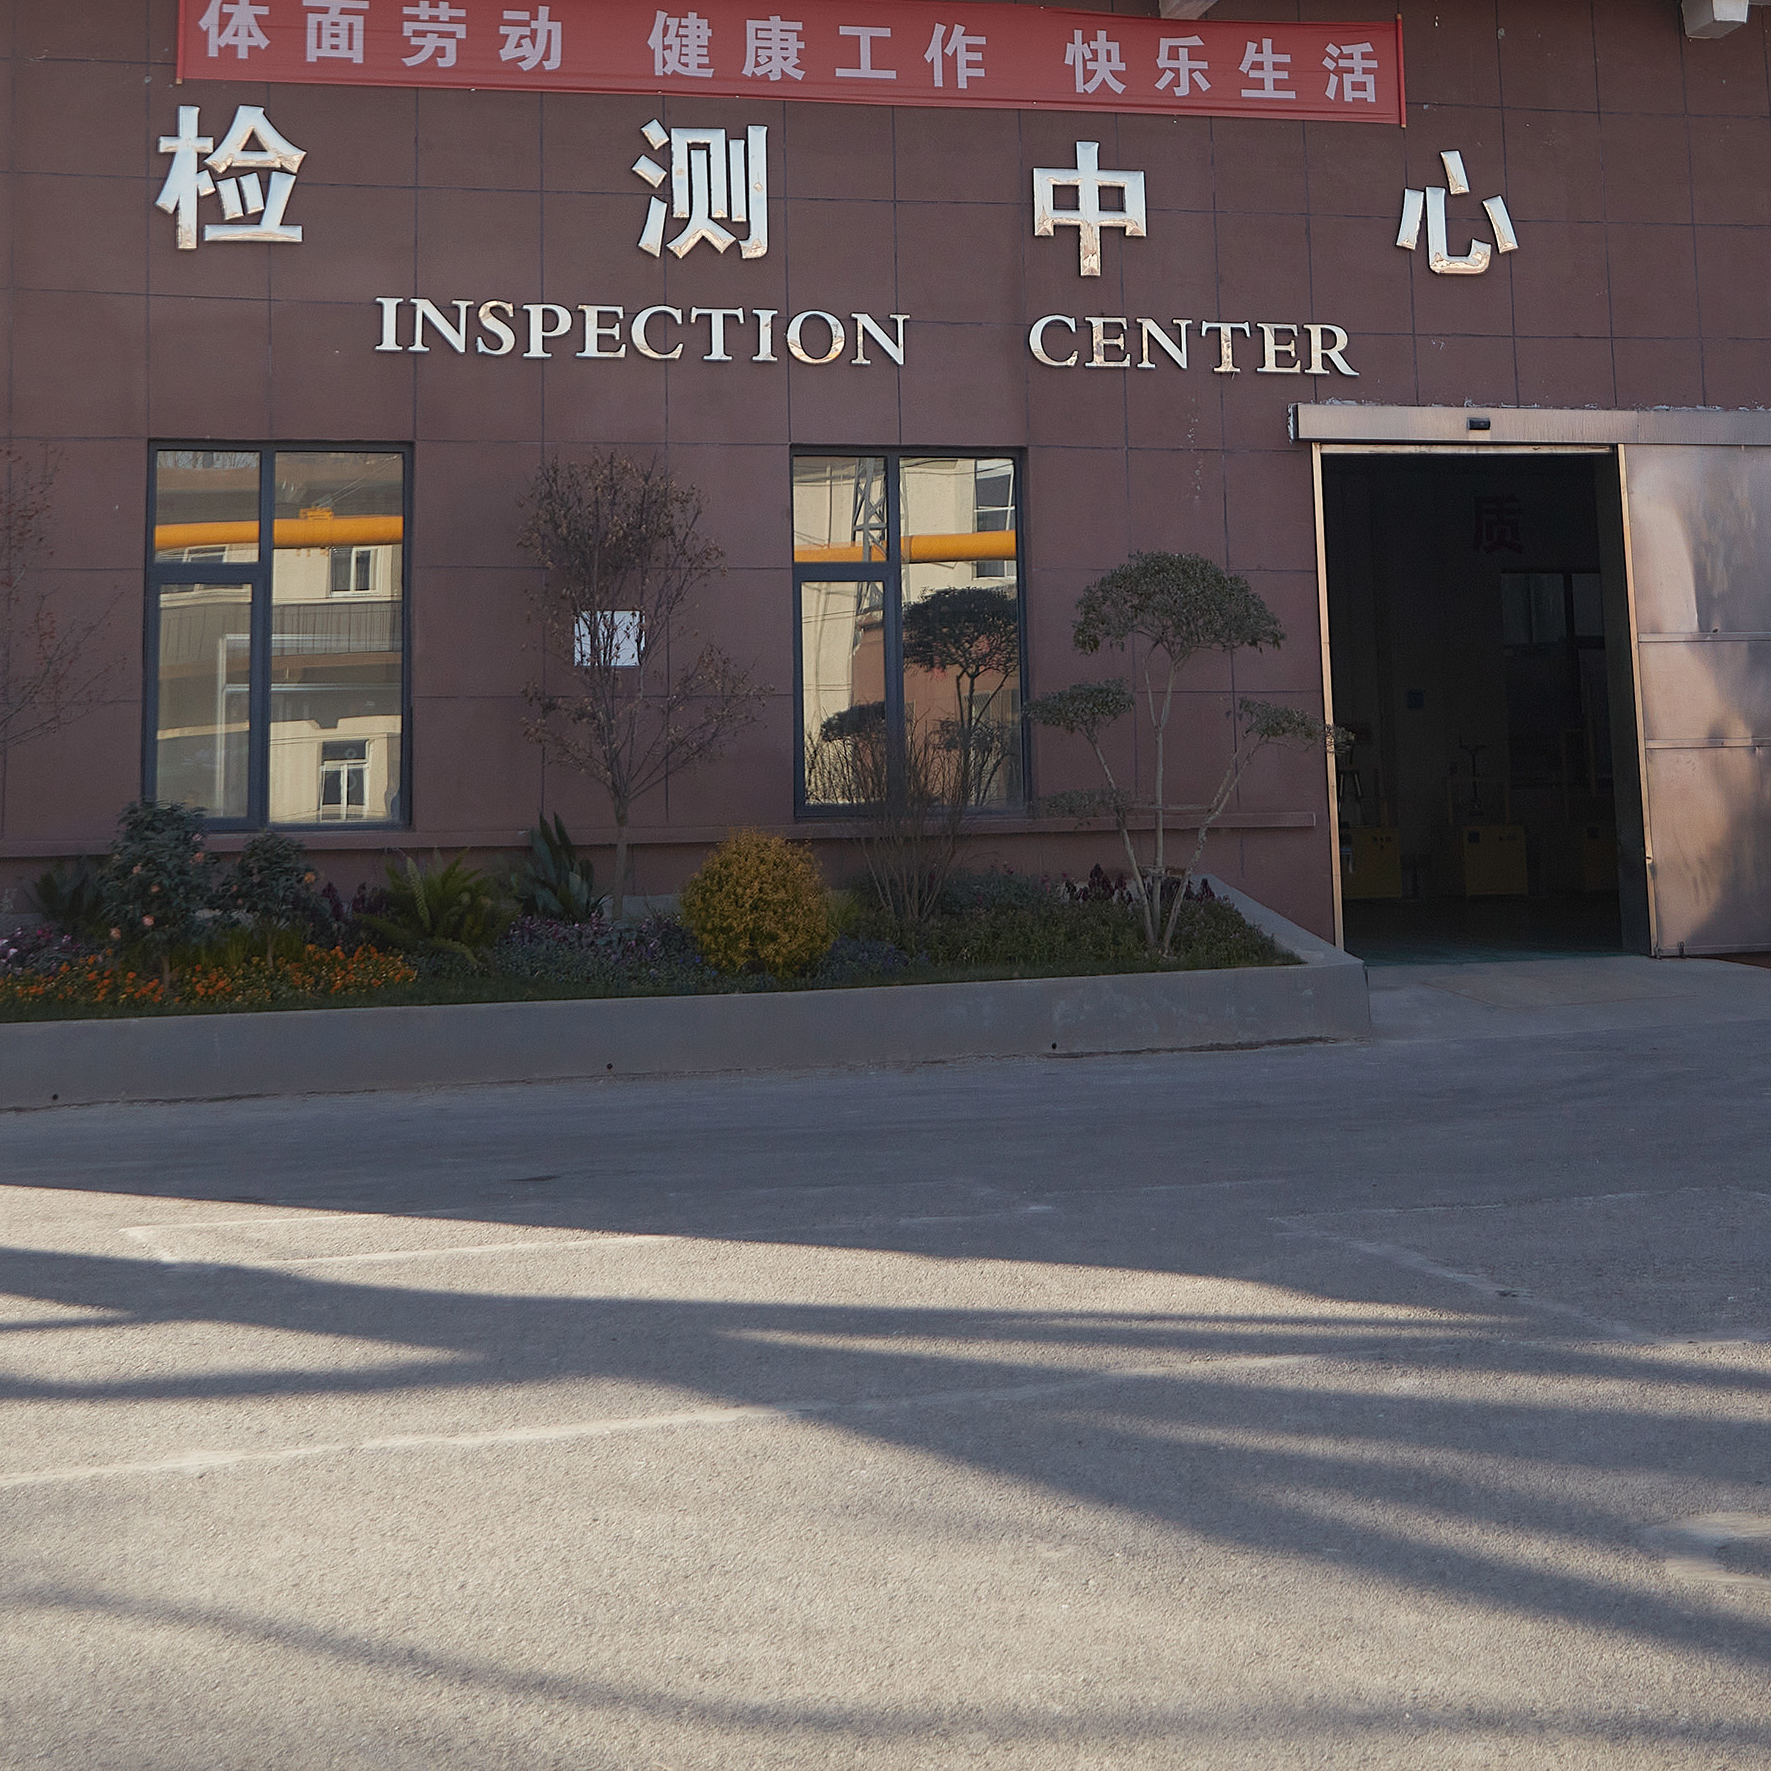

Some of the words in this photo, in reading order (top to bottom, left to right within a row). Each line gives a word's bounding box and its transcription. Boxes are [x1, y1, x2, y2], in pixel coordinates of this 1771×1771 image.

[646, 10, 988, 90] 健康工作
[1063, 29, 1380, 103] 快乐生活
[155, 104, 1520, 277] 检测中心
[374, 296, 912, 366] INSPECTION
[1027, 314, 1360, 377] CENTER
[1472, 494, 1523, 554] 质
